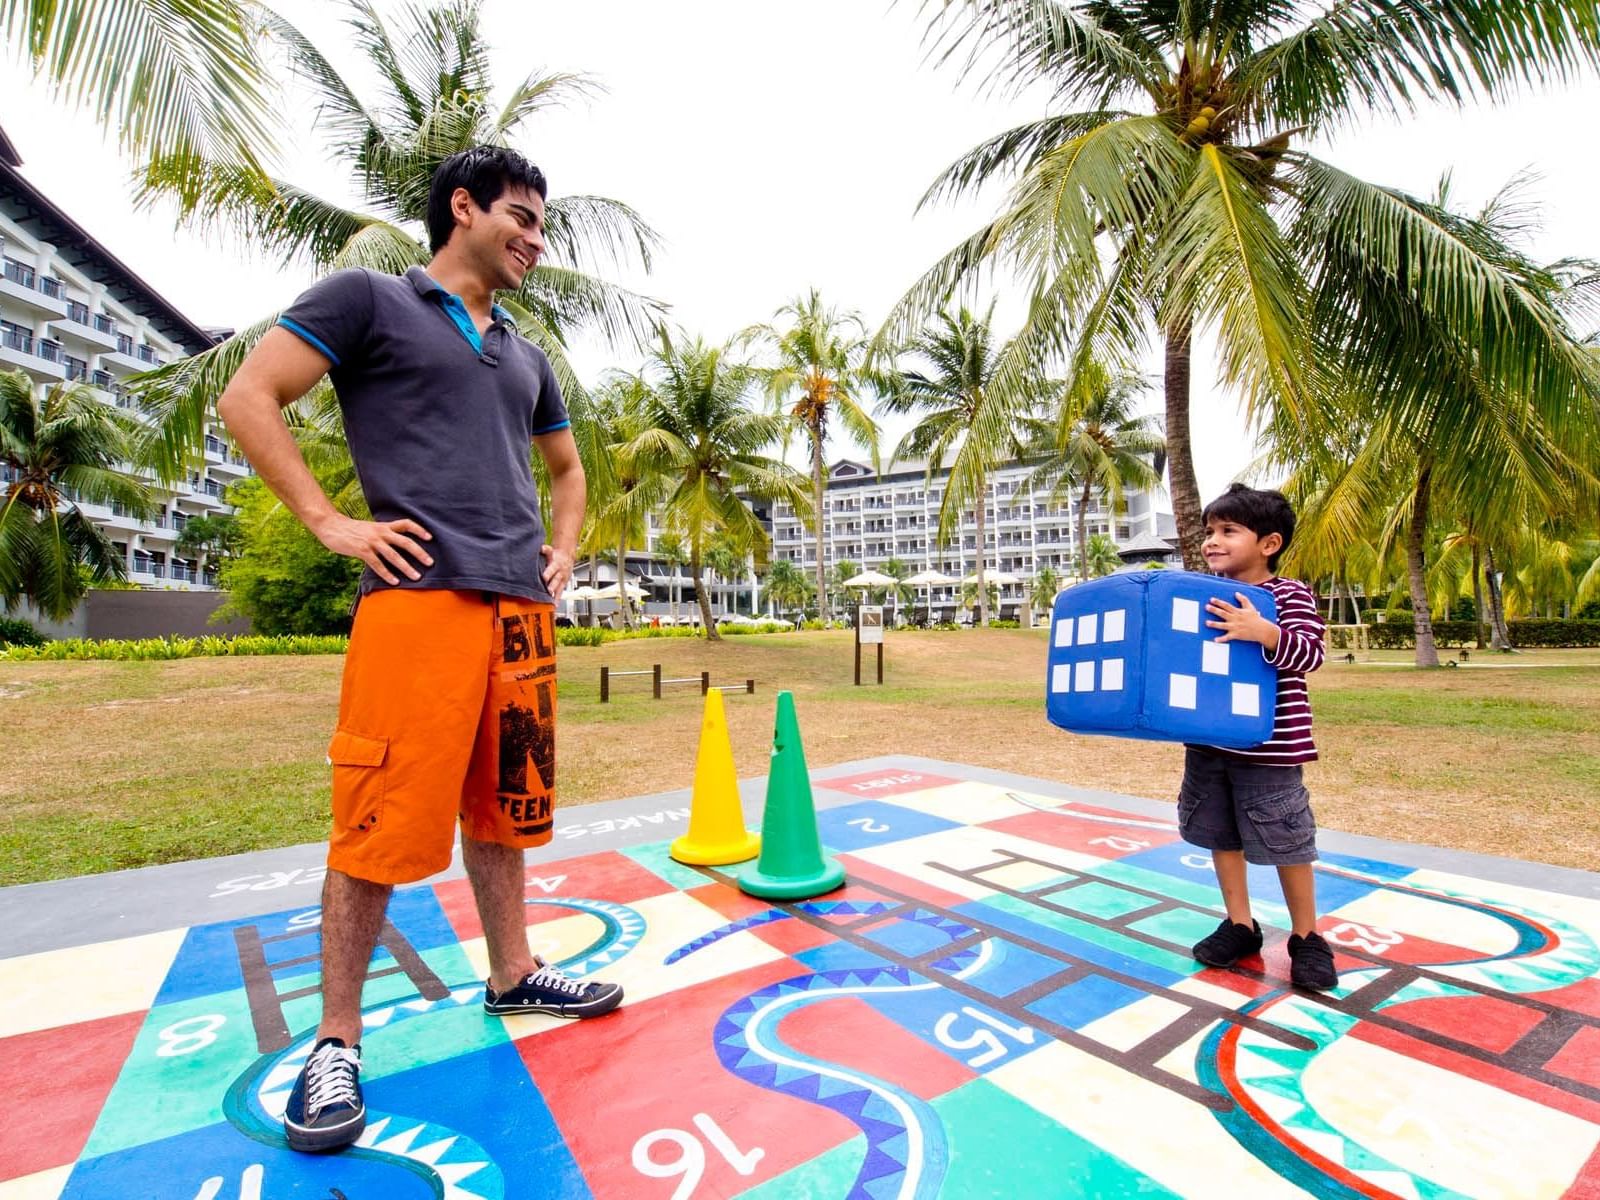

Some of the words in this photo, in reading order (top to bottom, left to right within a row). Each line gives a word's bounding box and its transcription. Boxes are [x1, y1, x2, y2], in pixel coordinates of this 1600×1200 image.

[851, 774, 923, 791] START
[557, 807, 692, 839] NAKES
[846, 818, 890, 833] 2
[524, 874, 568, 893] 4
[1322, 922, 1405, 955] 23
[156, 1013, 227, 1057] 8
[934, 1006, 1035, 1068] 15
[631, 1112, 766, 1200] 16
